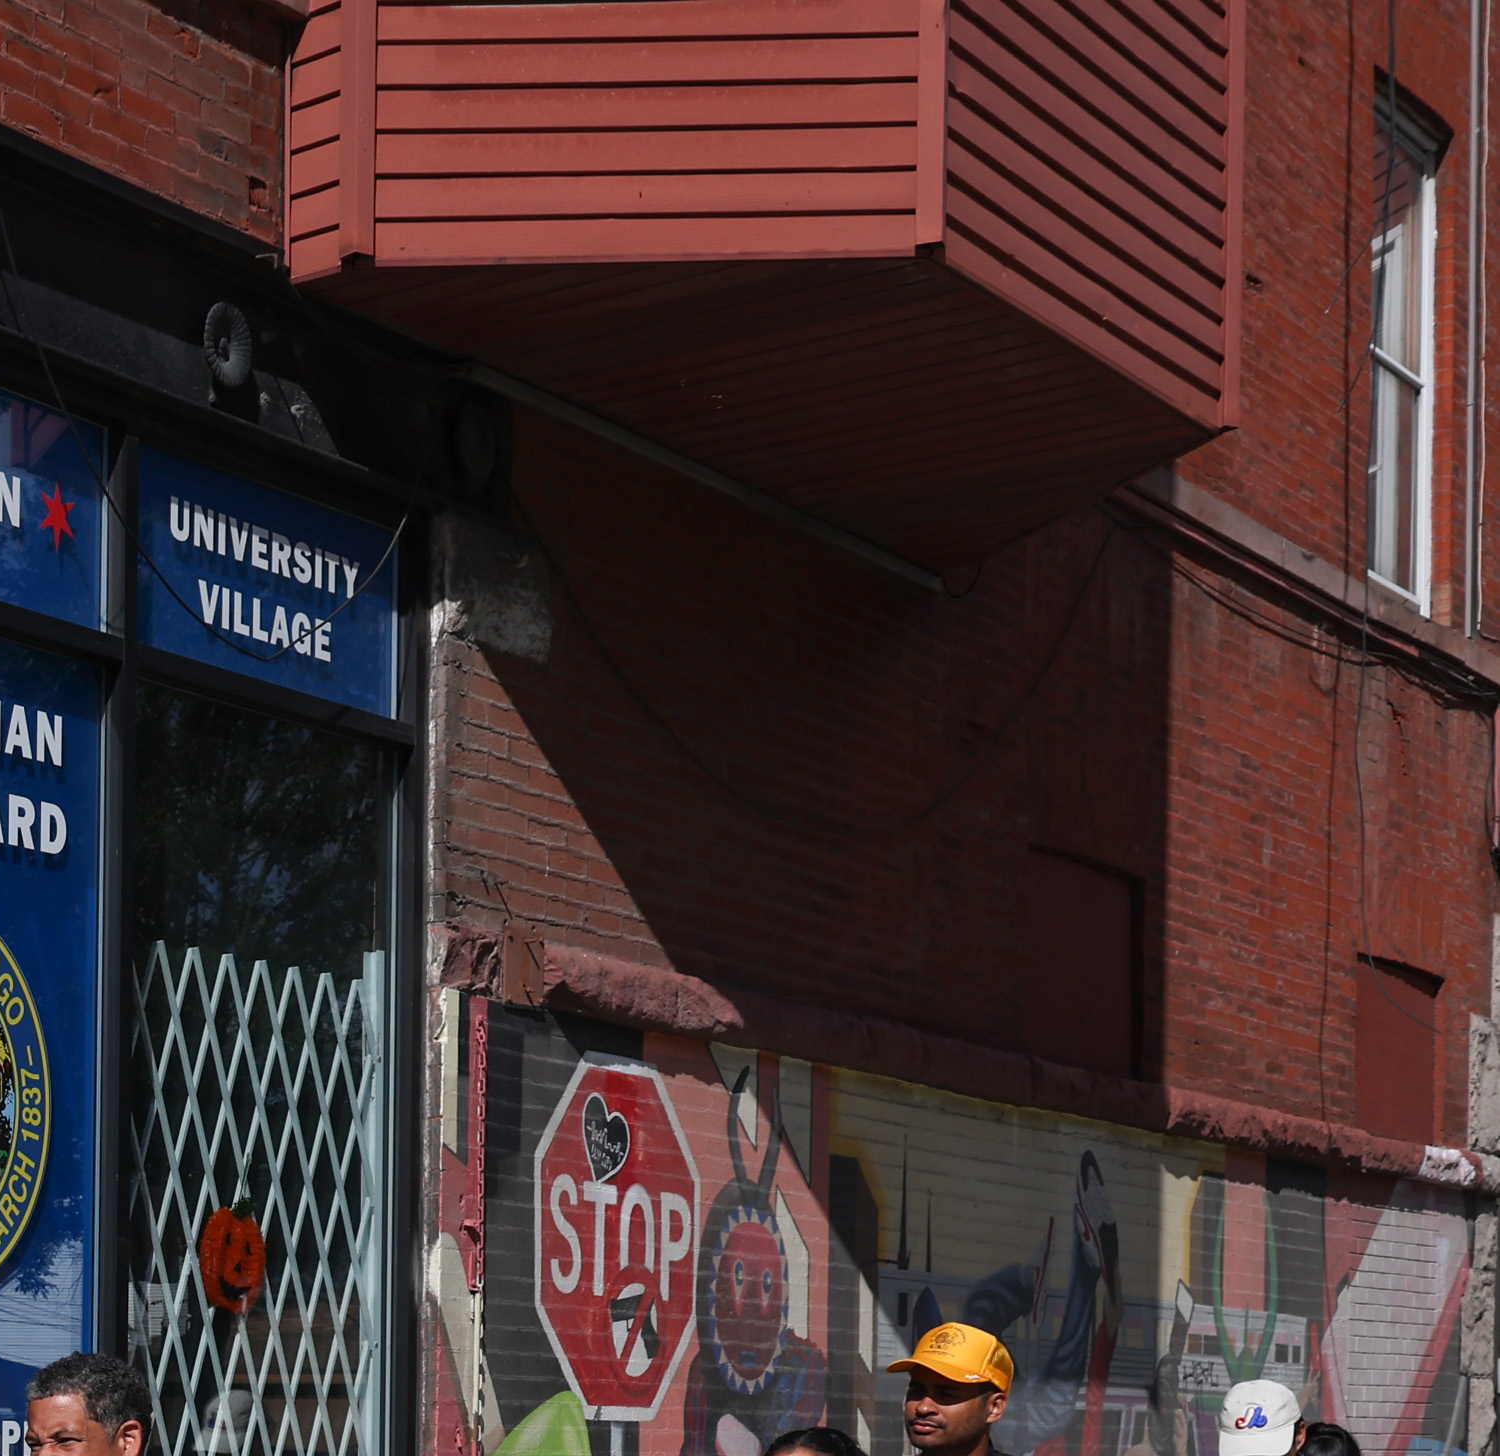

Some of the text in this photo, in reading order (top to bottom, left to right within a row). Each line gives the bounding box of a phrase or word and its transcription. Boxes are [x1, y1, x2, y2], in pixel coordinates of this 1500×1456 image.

[169, 495, 360, 599] UNIVERSITY
[197, 577, 333, 664] VILLAGE
[23, 1068, 43, 1143] 1837
[550, 1172, 693, 1302] STOP
